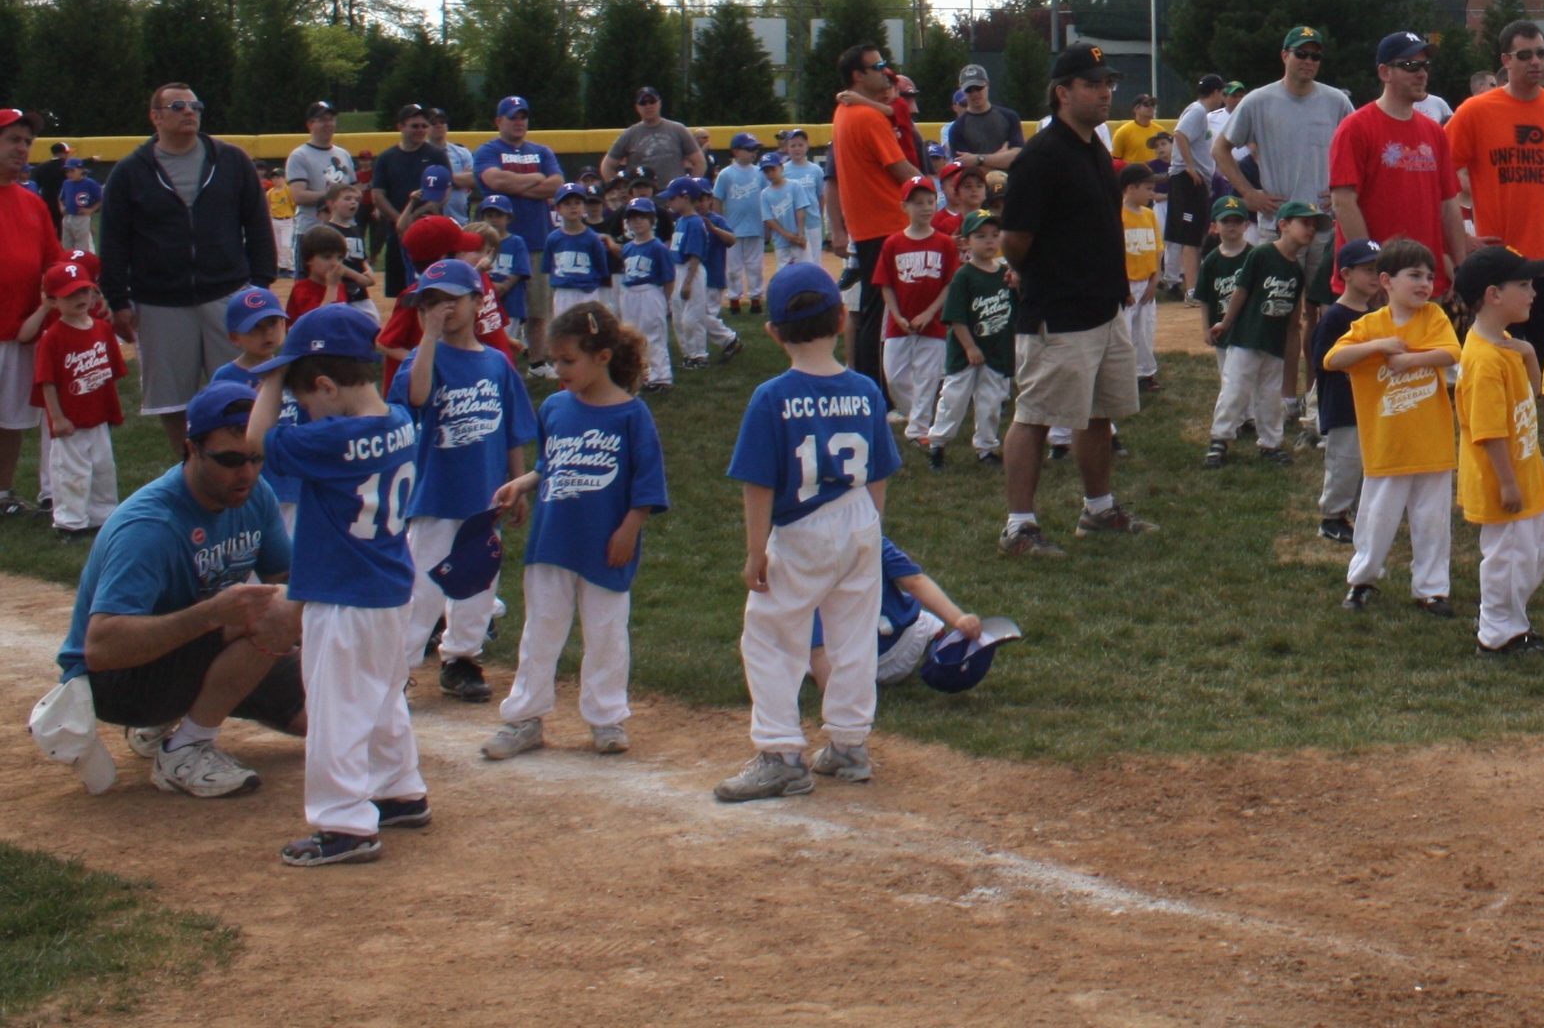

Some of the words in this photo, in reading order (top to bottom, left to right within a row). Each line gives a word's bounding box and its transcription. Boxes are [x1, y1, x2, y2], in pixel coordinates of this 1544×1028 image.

[1090, 47, 1102, 62] P
[426, 263, 446, 278] C
[244, 293, 266, 308] C
[782, 396, 815, 420] JCC
[818, 396, 871, 417] CAMPS
[1390, 387, 1432, 406] BASEBALL
[439, 397, 502, 420] Atlantic
[344, 435, 384, 461] JCC
[582, 428, 621, 452] Hill
[547, 450, 618, 472] Atlantic
[795, 432, 869, 503] 13
[348, 460, 417, 540] 10
